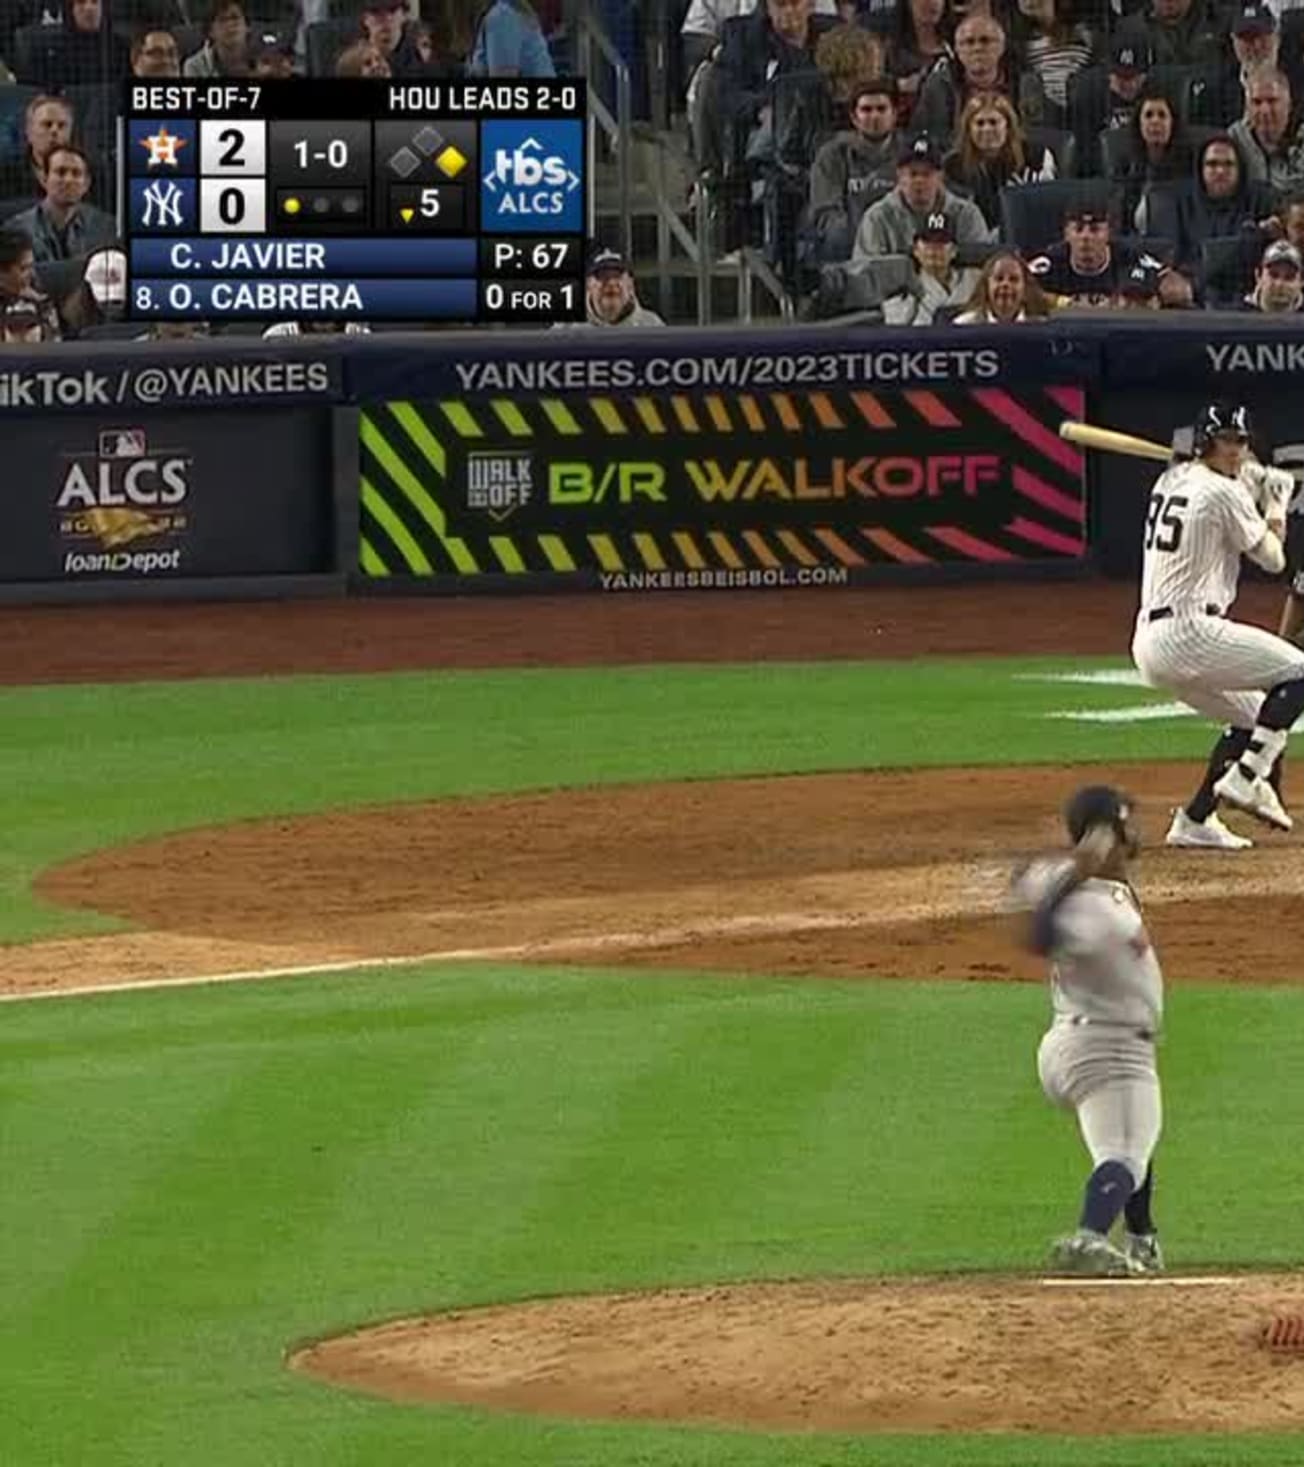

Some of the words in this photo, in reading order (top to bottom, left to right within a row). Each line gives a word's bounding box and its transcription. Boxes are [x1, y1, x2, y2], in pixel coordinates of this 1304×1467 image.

[456, 350, 999, 391] YANKEES.COM/2023TICKETS
[57, 461, 187, 506] ALCS
[549, 461, 665, 503] B/R
[684, 454, 998, 501] WALKOFF
[65, 551, 180, 573] loanDepot
